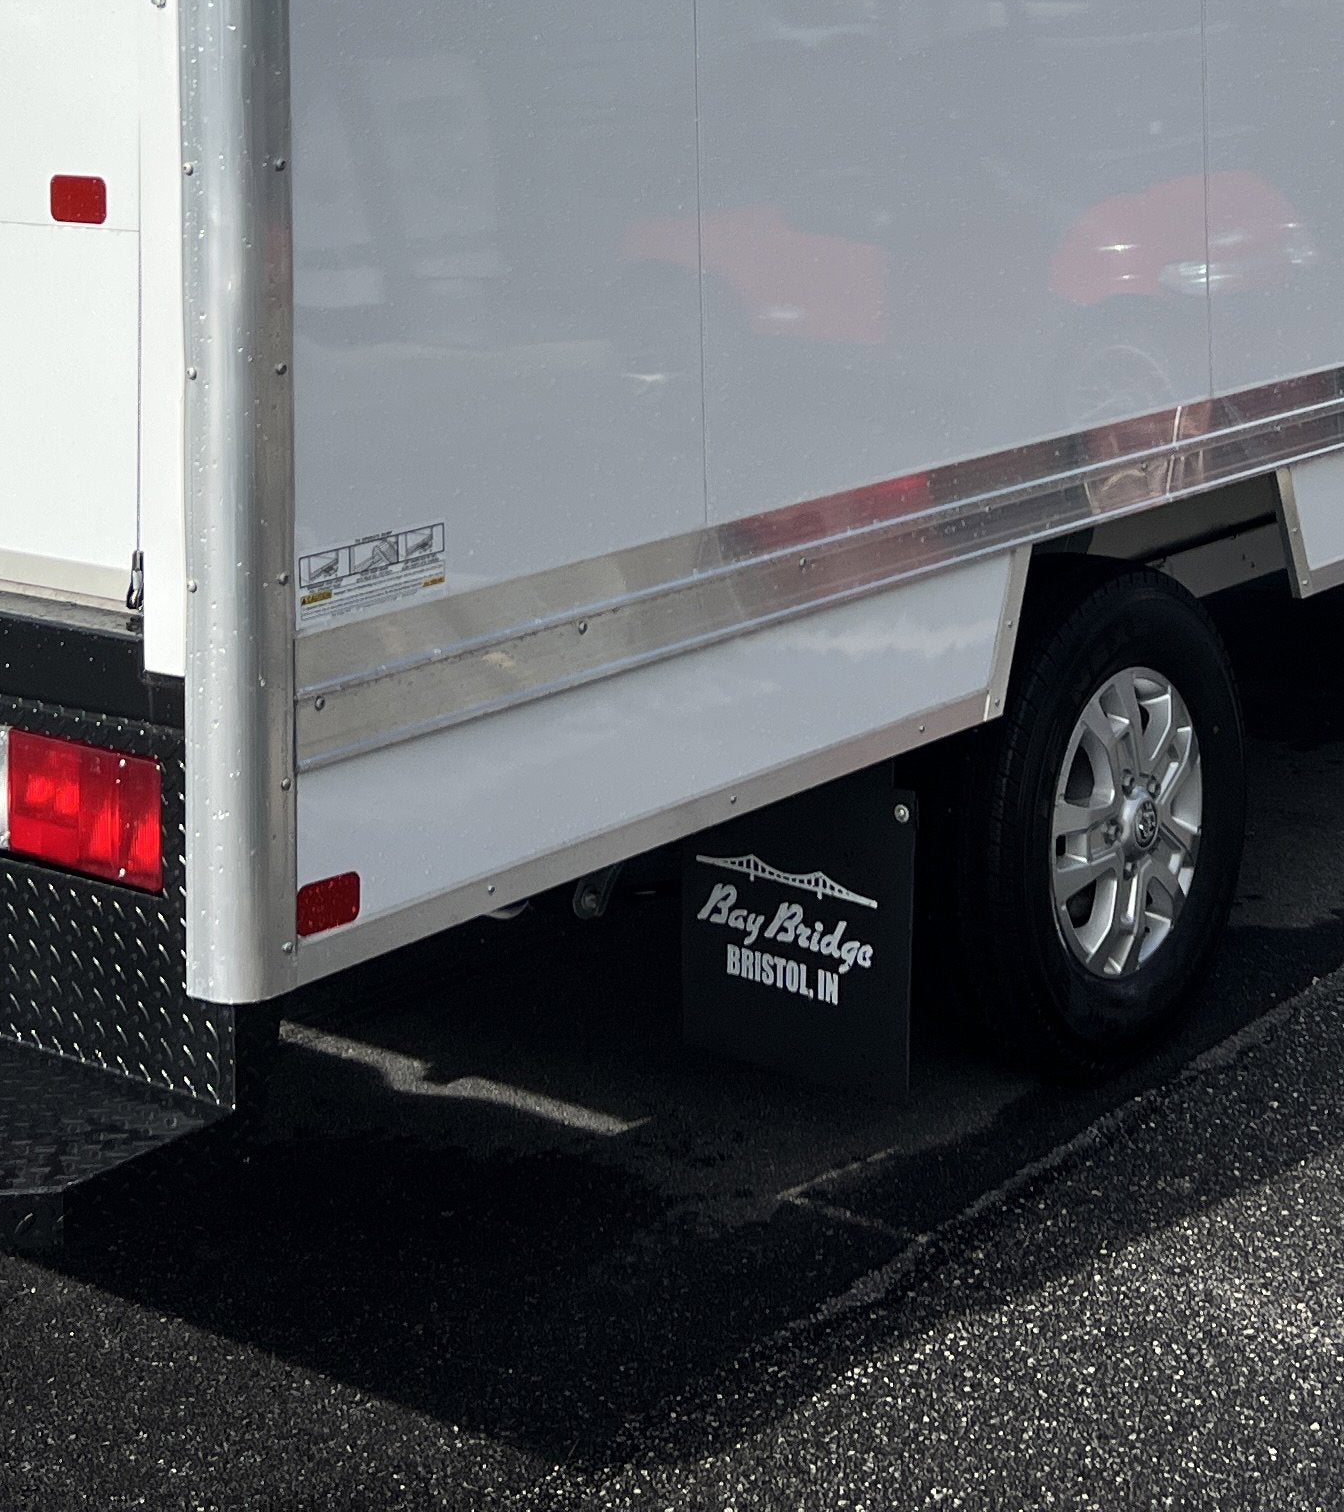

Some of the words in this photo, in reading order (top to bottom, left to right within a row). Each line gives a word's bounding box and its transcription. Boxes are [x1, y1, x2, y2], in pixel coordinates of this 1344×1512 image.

[697, 883, 765, 945] Bay
[764, 902, 874, 974] Bridge
[818, 969, 839, 1005] IN
